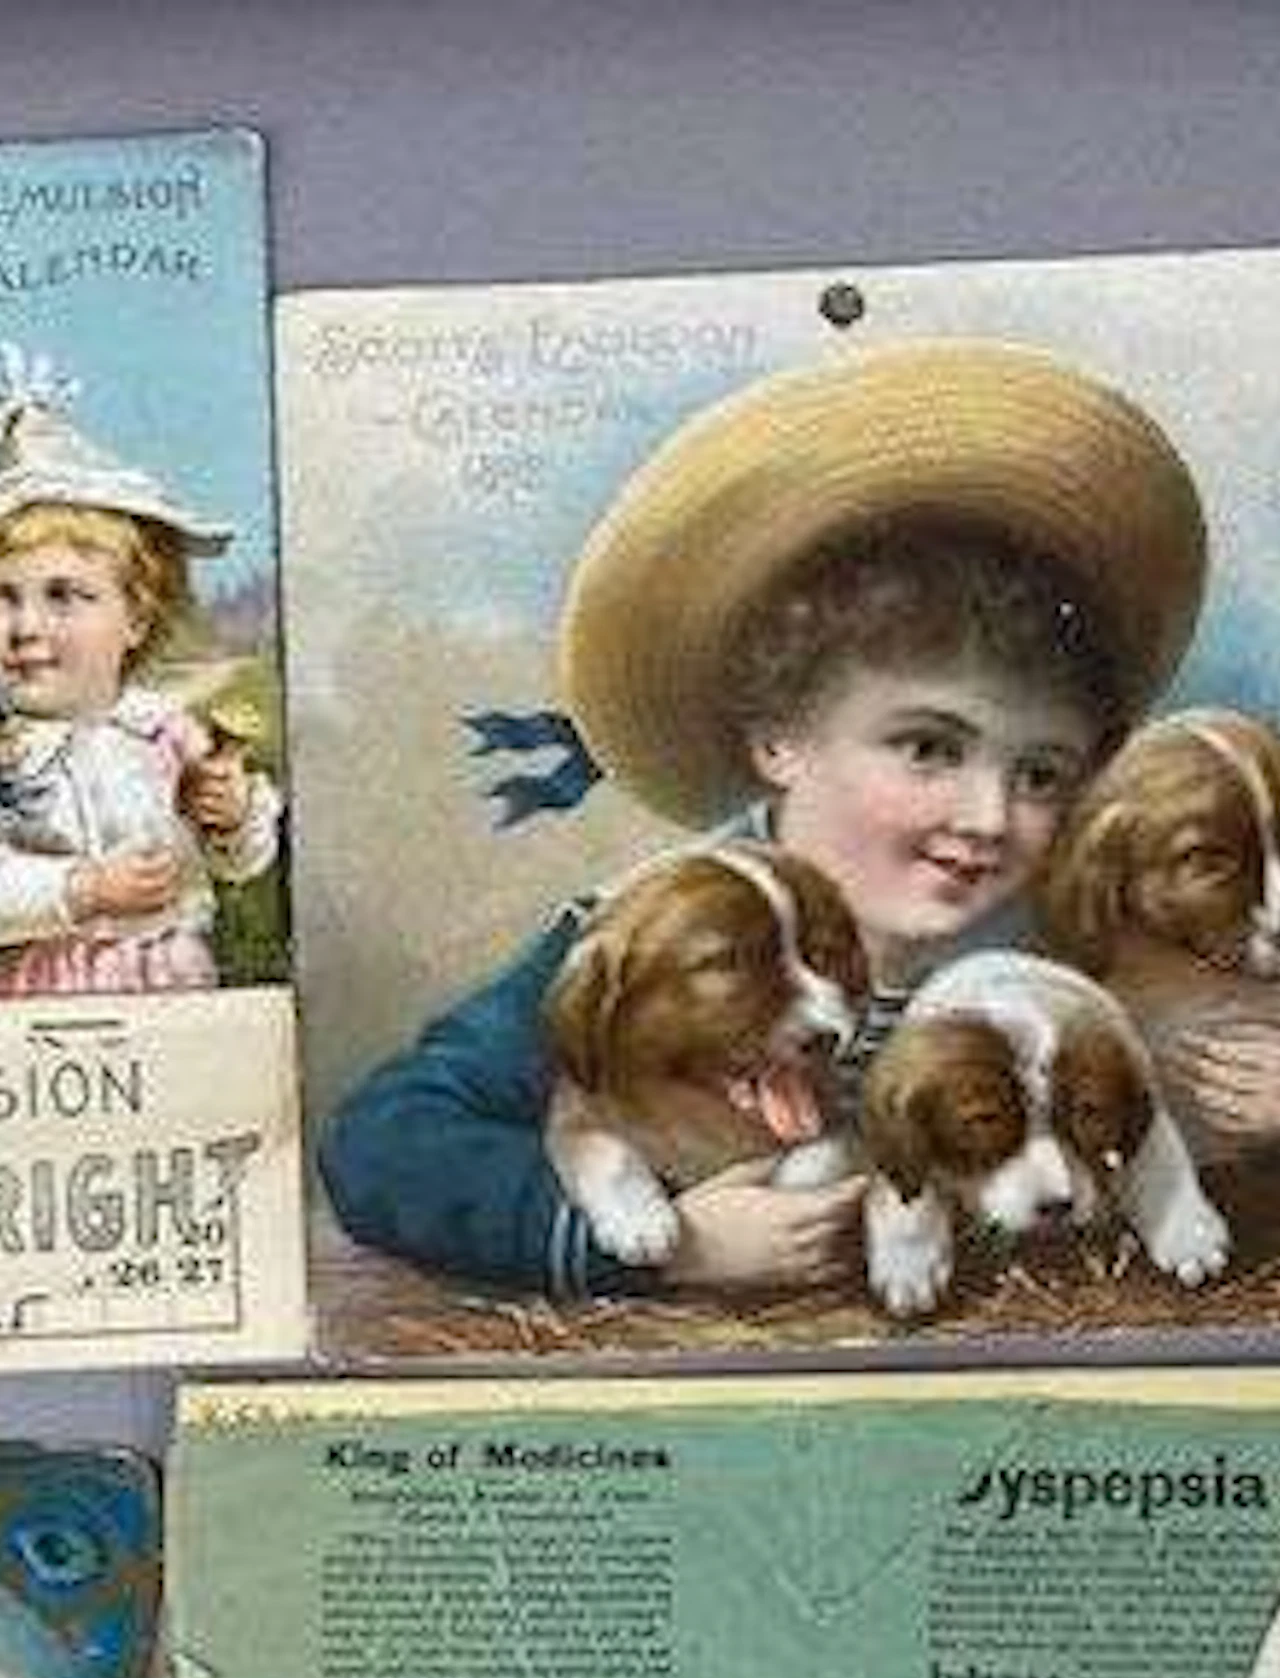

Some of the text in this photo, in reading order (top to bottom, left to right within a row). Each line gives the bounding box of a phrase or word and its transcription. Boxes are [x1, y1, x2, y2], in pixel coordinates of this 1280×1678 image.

[326, 1443, 672, 1475] King of Medicines
